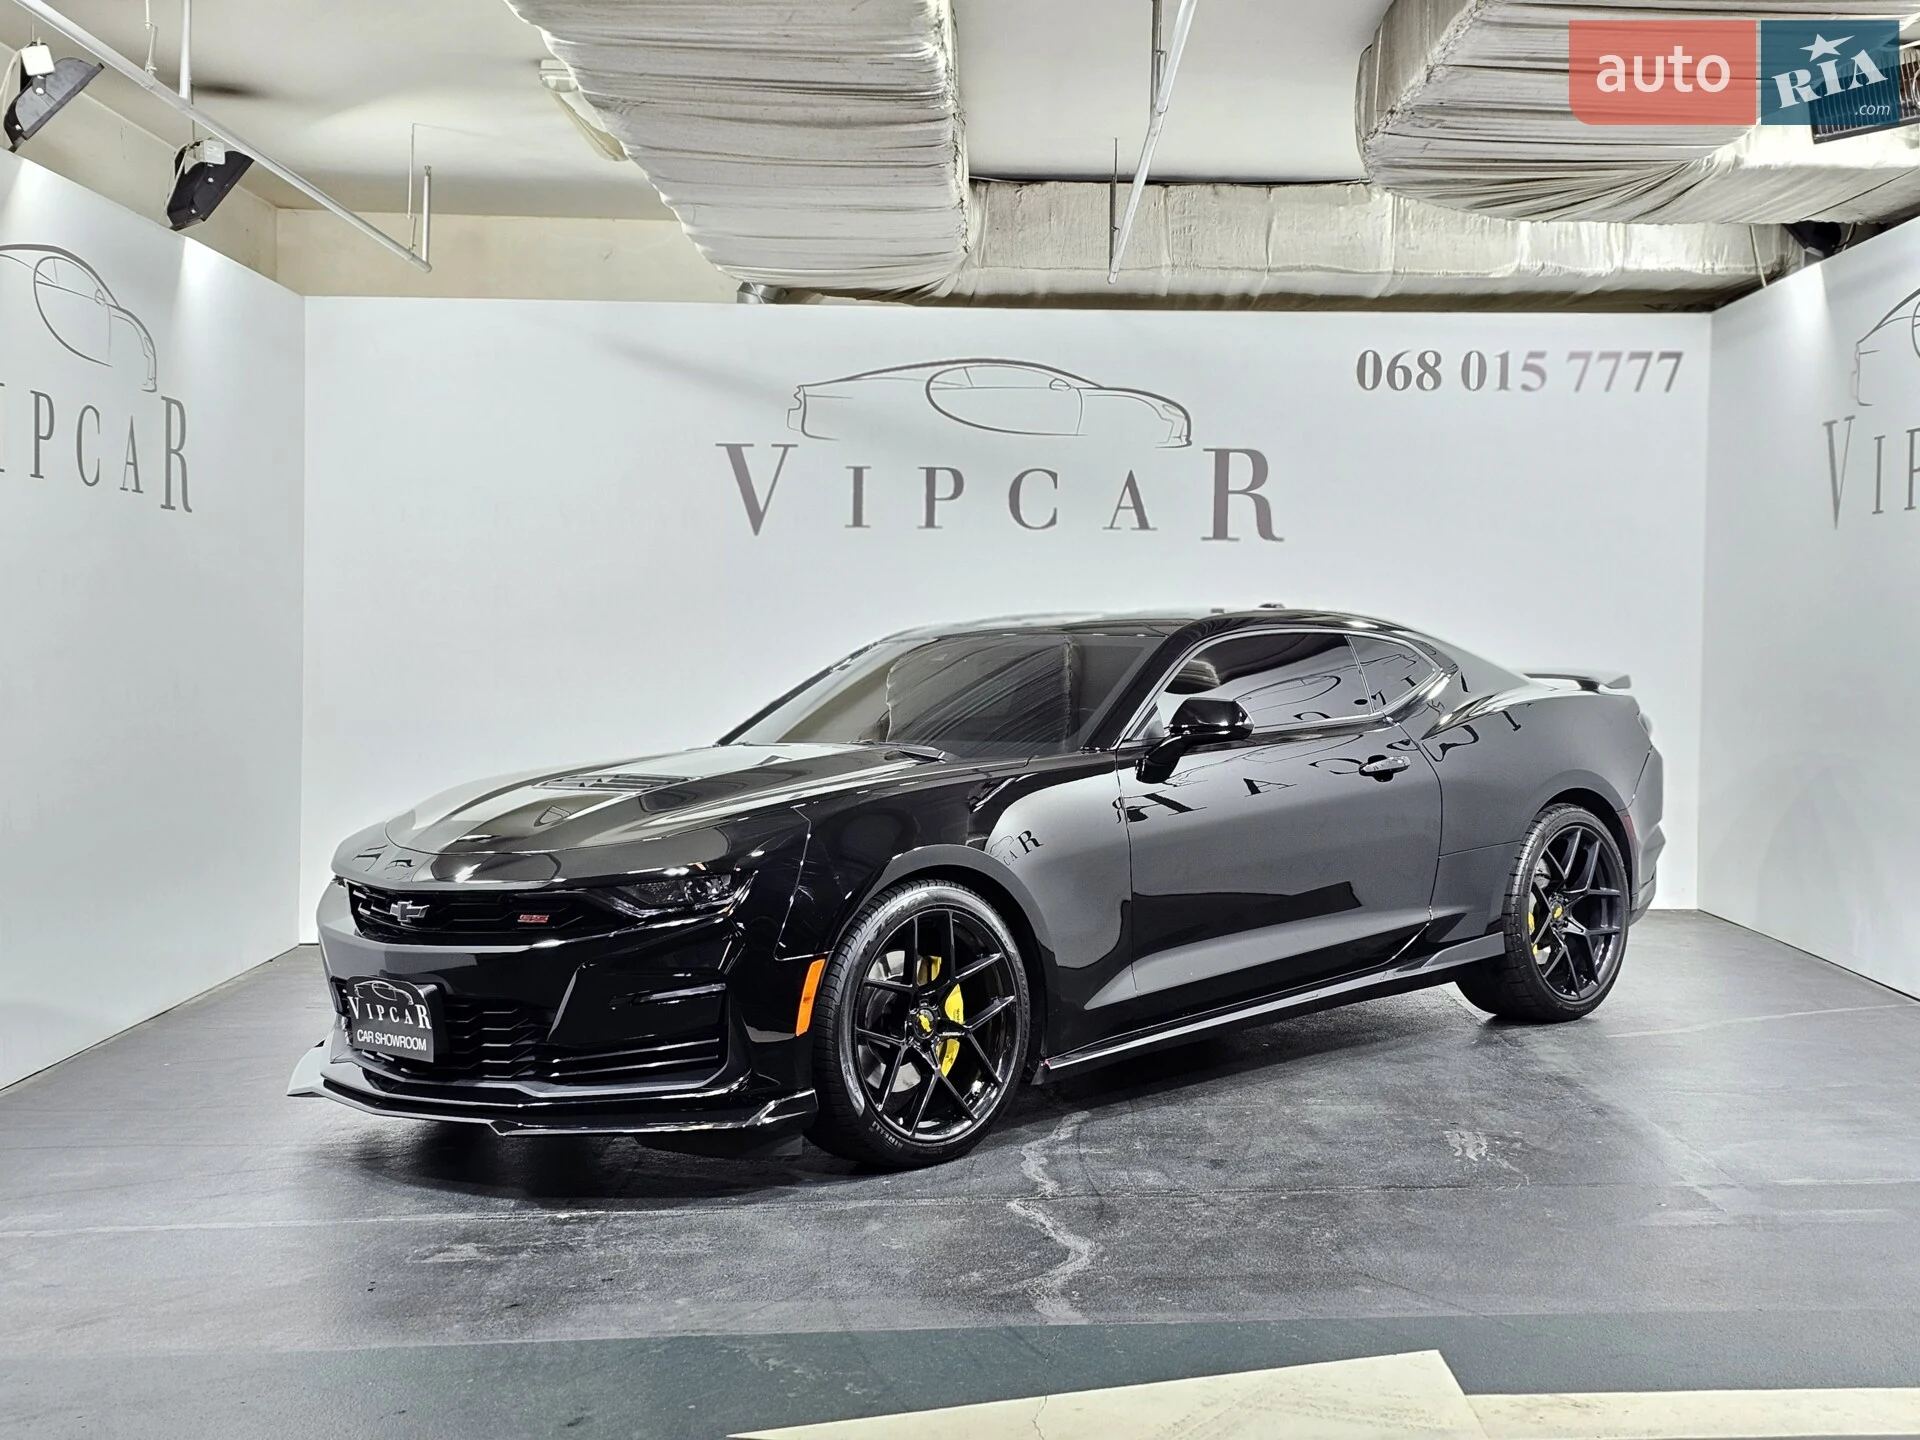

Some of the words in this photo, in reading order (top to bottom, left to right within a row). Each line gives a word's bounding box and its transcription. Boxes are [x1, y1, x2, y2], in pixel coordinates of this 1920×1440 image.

[1356, 350, 1442, 391] 068
[1461, 350, 1547, 392] 015
[1566, 351, 1684, 393] 7777
[0, 382, 192, 513] PCAR
[715, 443, 1285, 542] VIPCAR
[347, 996, 432, 1029] VIPCAR
[357, 1029, 375, 1045] CAR
[375, 1031, 427, 1051] SHOWROOM
